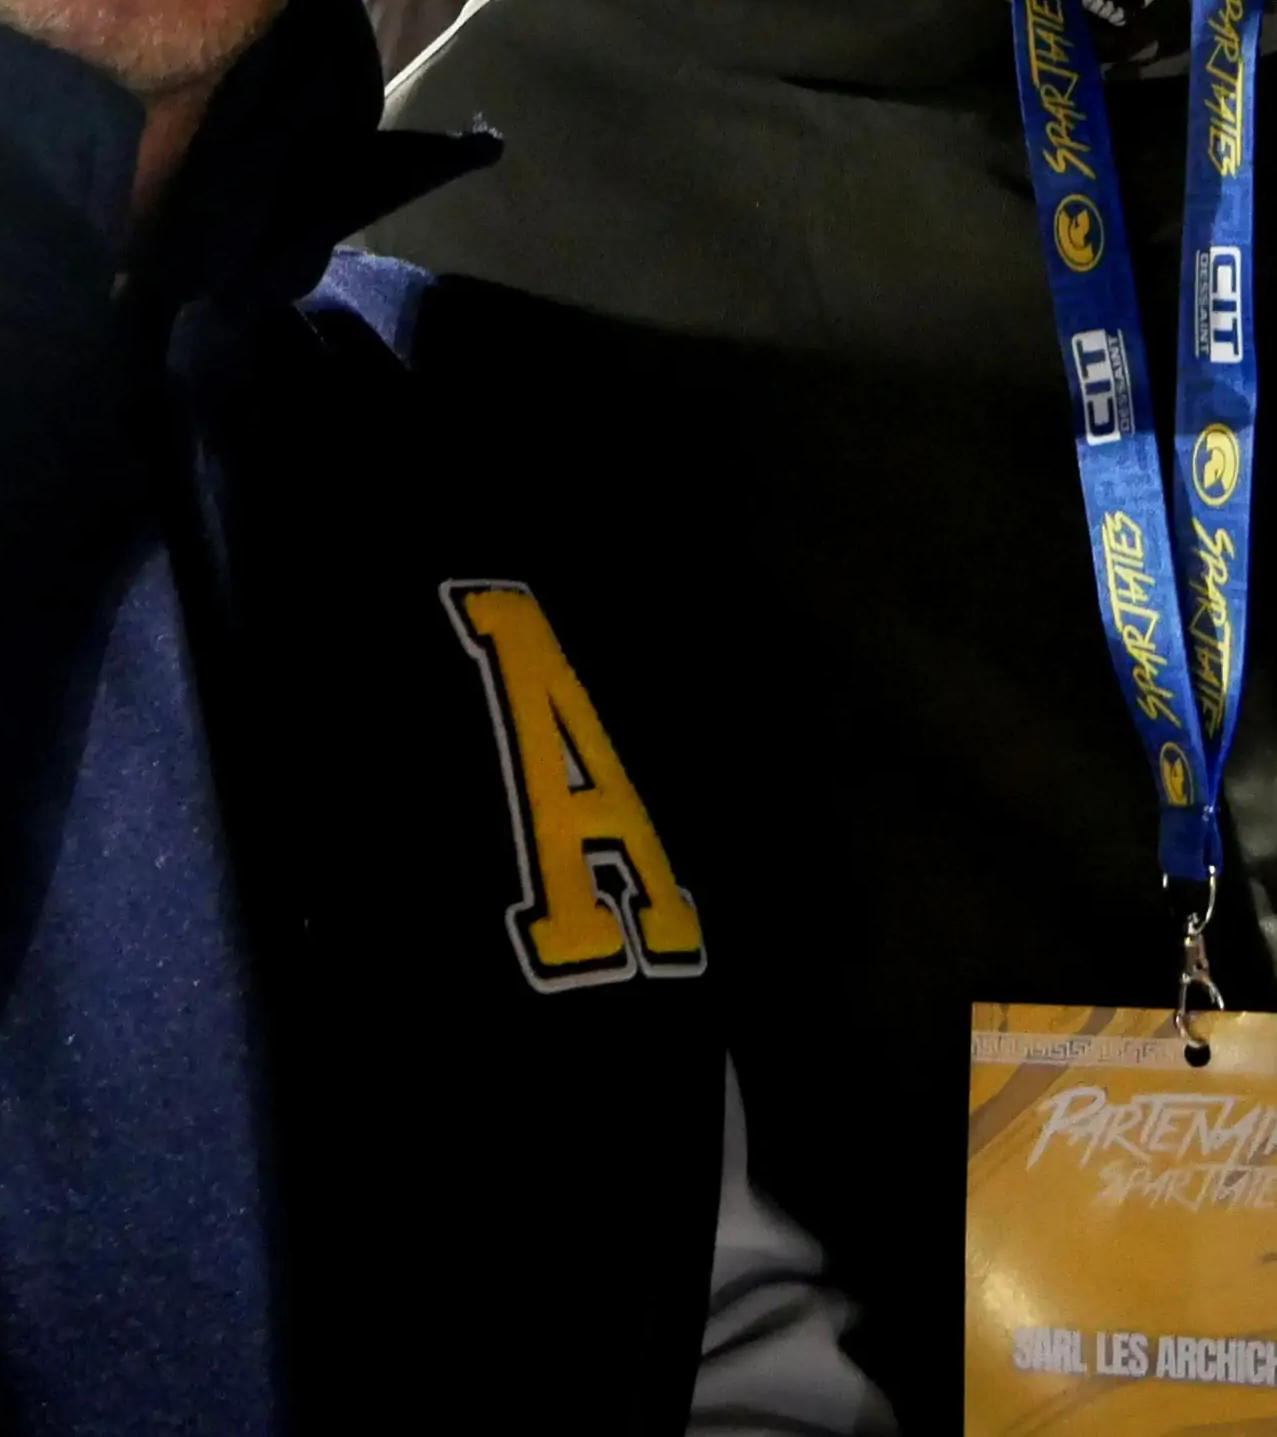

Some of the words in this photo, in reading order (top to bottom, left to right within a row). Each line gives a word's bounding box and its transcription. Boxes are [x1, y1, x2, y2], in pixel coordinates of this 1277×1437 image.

[1211, 253, 1240, 356] CIT
[1075, 338, 1116, 437] CIT
[438, 578, 708, 994] A
[1011, 1325, 1087, 1373] SARL
[1094, 1330, 1149, 1376] LES
